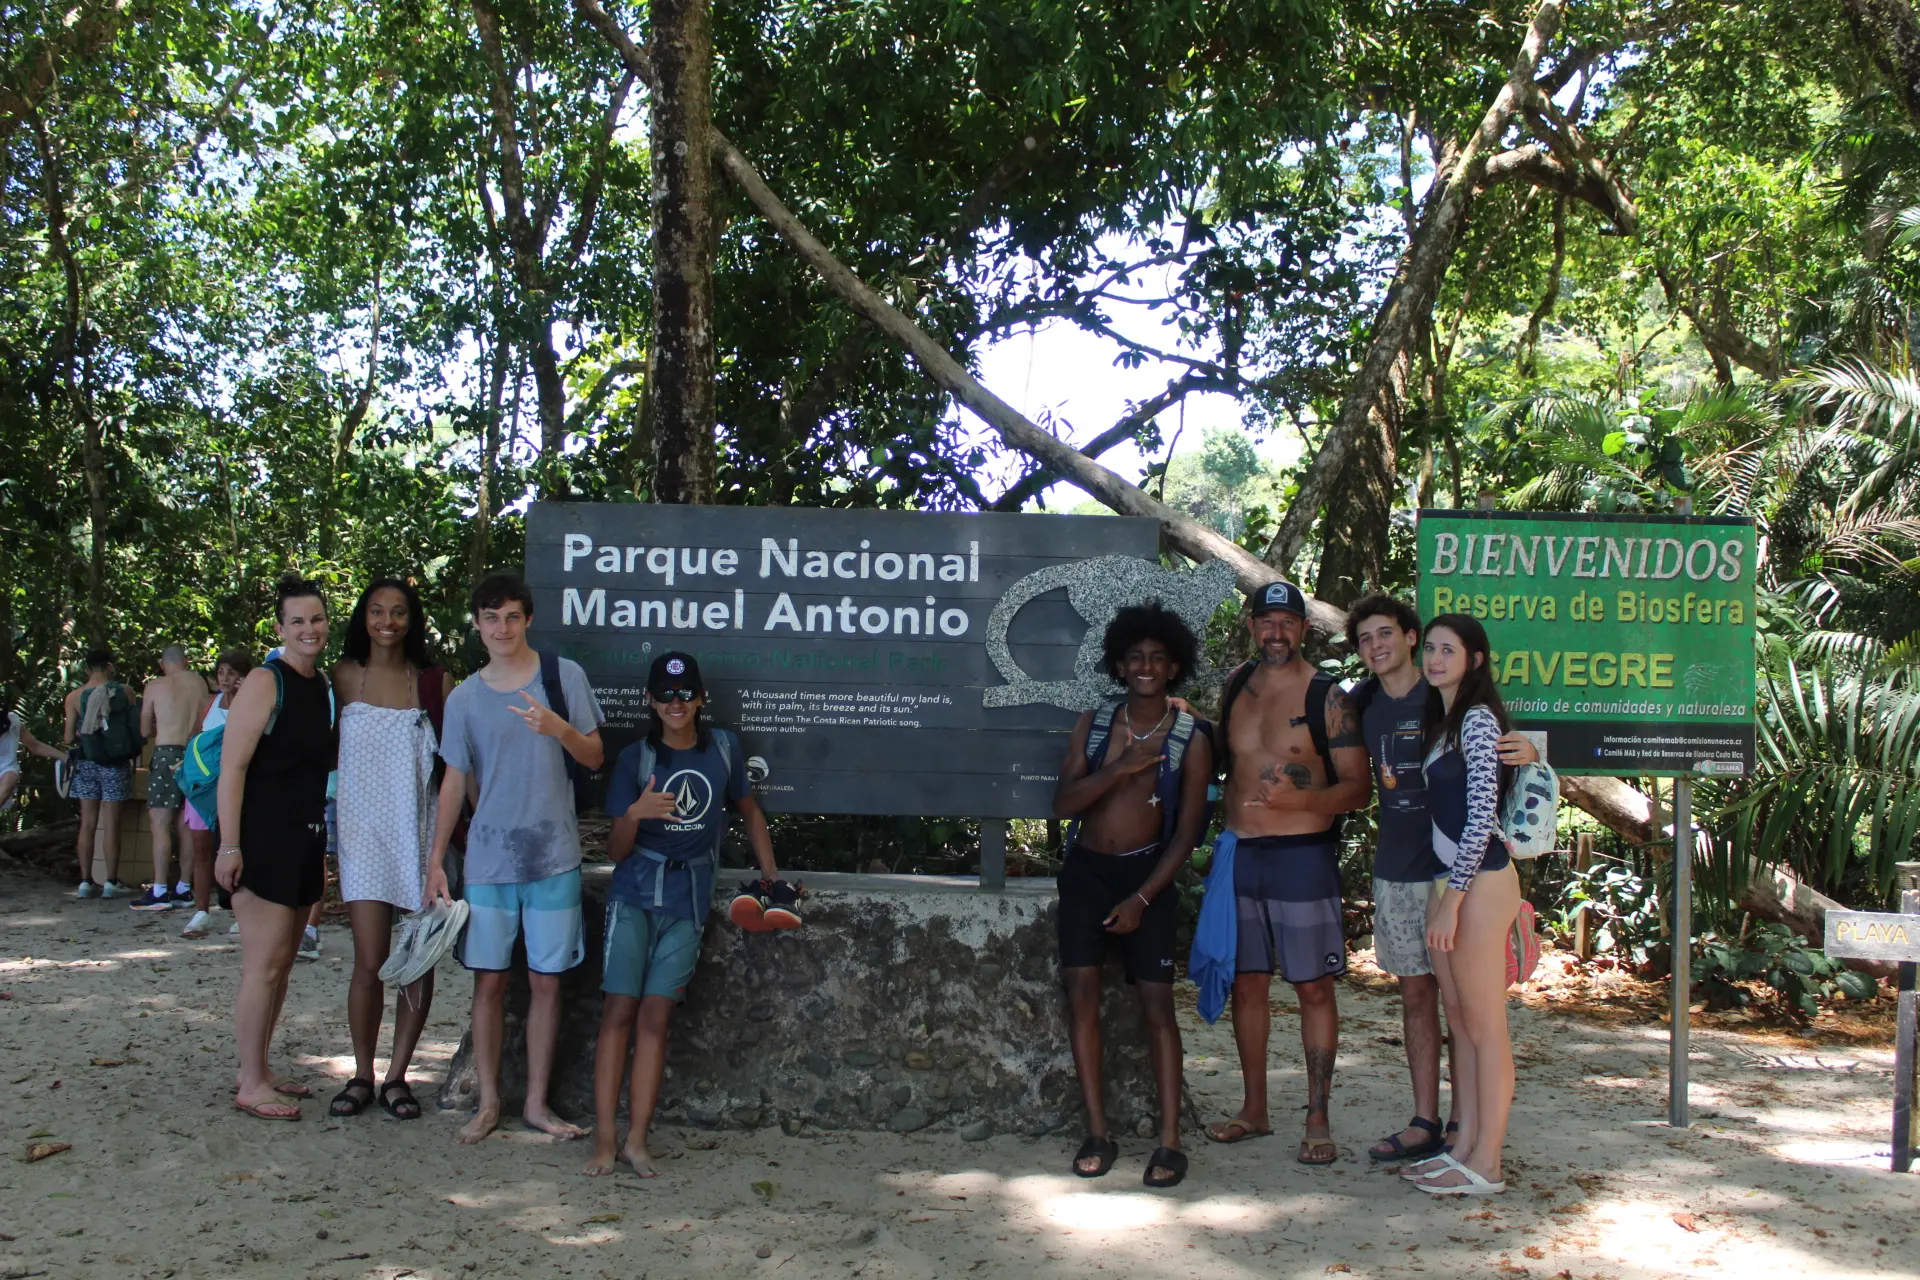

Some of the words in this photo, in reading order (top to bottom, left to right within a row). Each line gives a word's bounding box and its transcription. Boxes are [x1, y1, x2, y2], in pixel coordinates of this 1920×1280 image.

[563, 533, 739, 586] Parque
[759, 537, 980, 582] Nacional
[1429, 532, 1744, 582] BIENVENIDOS
[562, 587, 744, 630] Manuel
[763, 592, 970, 637] Antonio
[1434, 586, 1557, 620] Reserva
[1569, 590, 1605, 622] de
[1617, 590, 1745, 625] Biosfera
[771, 648, 880, 671] National
[889, 650, 947, 672] Park
[742, 700, 762, 709] with
[764, 700, 777, 710] its
[778, 701, 806, 712] palm,
[808, 701, 821, 711] its
[823, 702, 856, 712] breeze
[858, 703, 877, 713] and
[879, 703, 891, 713] its
[752, 689, 798, 700] thousand
[800, 690, 826, 700] times
[856, 692, 900, 703] beautiful
[901, 695, 917, 706] my
[919, 693, 941, 704] land
[942, 694, 953, 705] is,
[1553, 698, 1570, 714] de
[1574, 699, 1662, 715] comunidades
[1665, 702, 1674, 718] y
[1677, 701, 1746, 717] naturaleza
[741, 713, 772, 723] Excerpt
[774, 714, 794, 723] from
[796, 715, 812, 723] The
[813, 715, 837, 724] Costa
[839, 716, 861, 725] Rican
[863, 717, 898, 726] Patriotic
[741, 724, 778, 732] unknown
[779, 725, 806, 733] author
[1603, 735, 1642, 744] Información
[663, 823, 706, 832] VOLCOM
[1836, 920, 1911, 945] PLAYA
